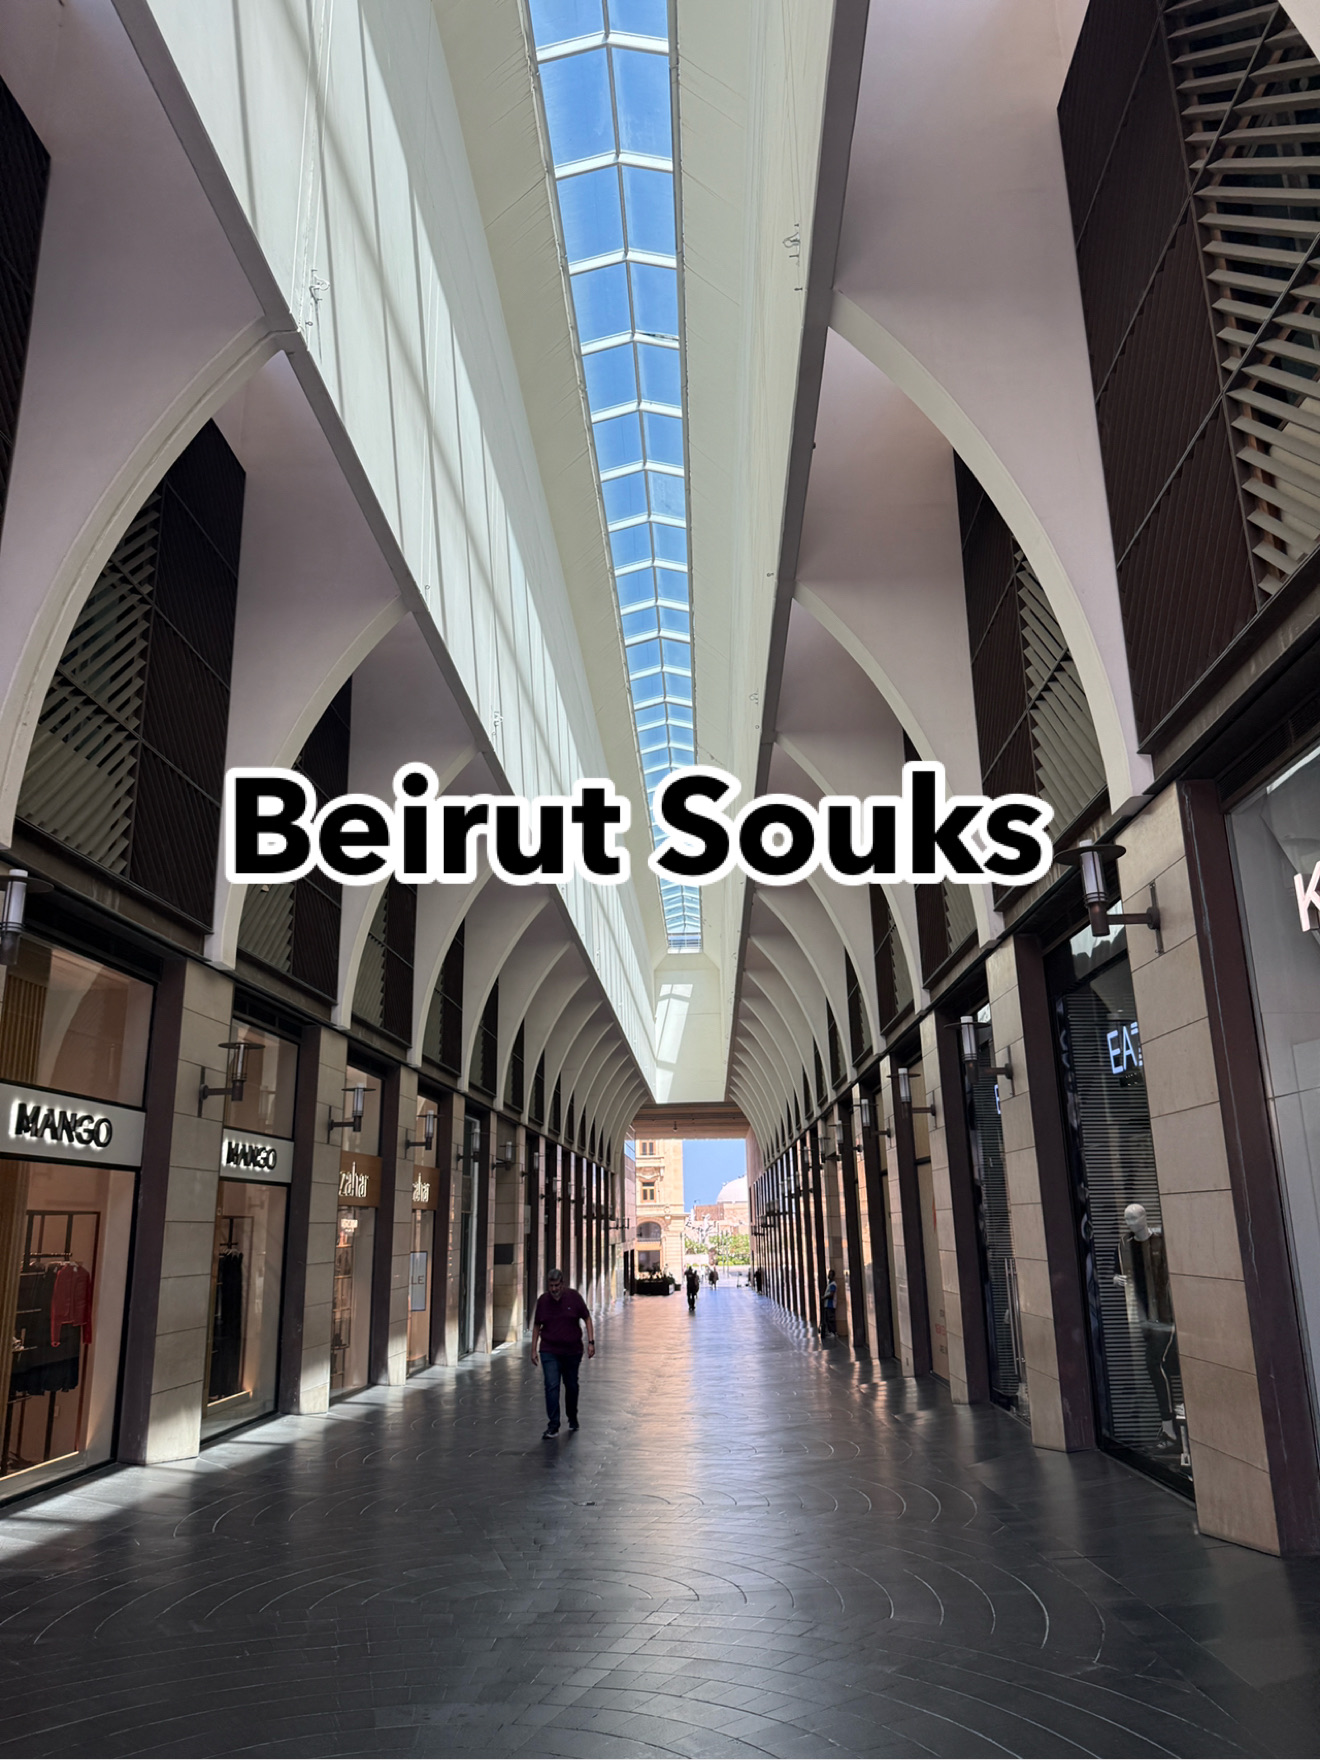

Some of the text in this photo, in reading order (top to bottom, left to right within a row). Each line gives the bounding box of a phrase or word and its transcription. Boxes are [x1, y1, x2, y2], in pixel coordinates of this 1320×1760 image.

[13, 1102, 113, 1148] MANGO
[224, 1140, 277, 1171] MANGO
[411, 1172, 430, 1203] ahar
